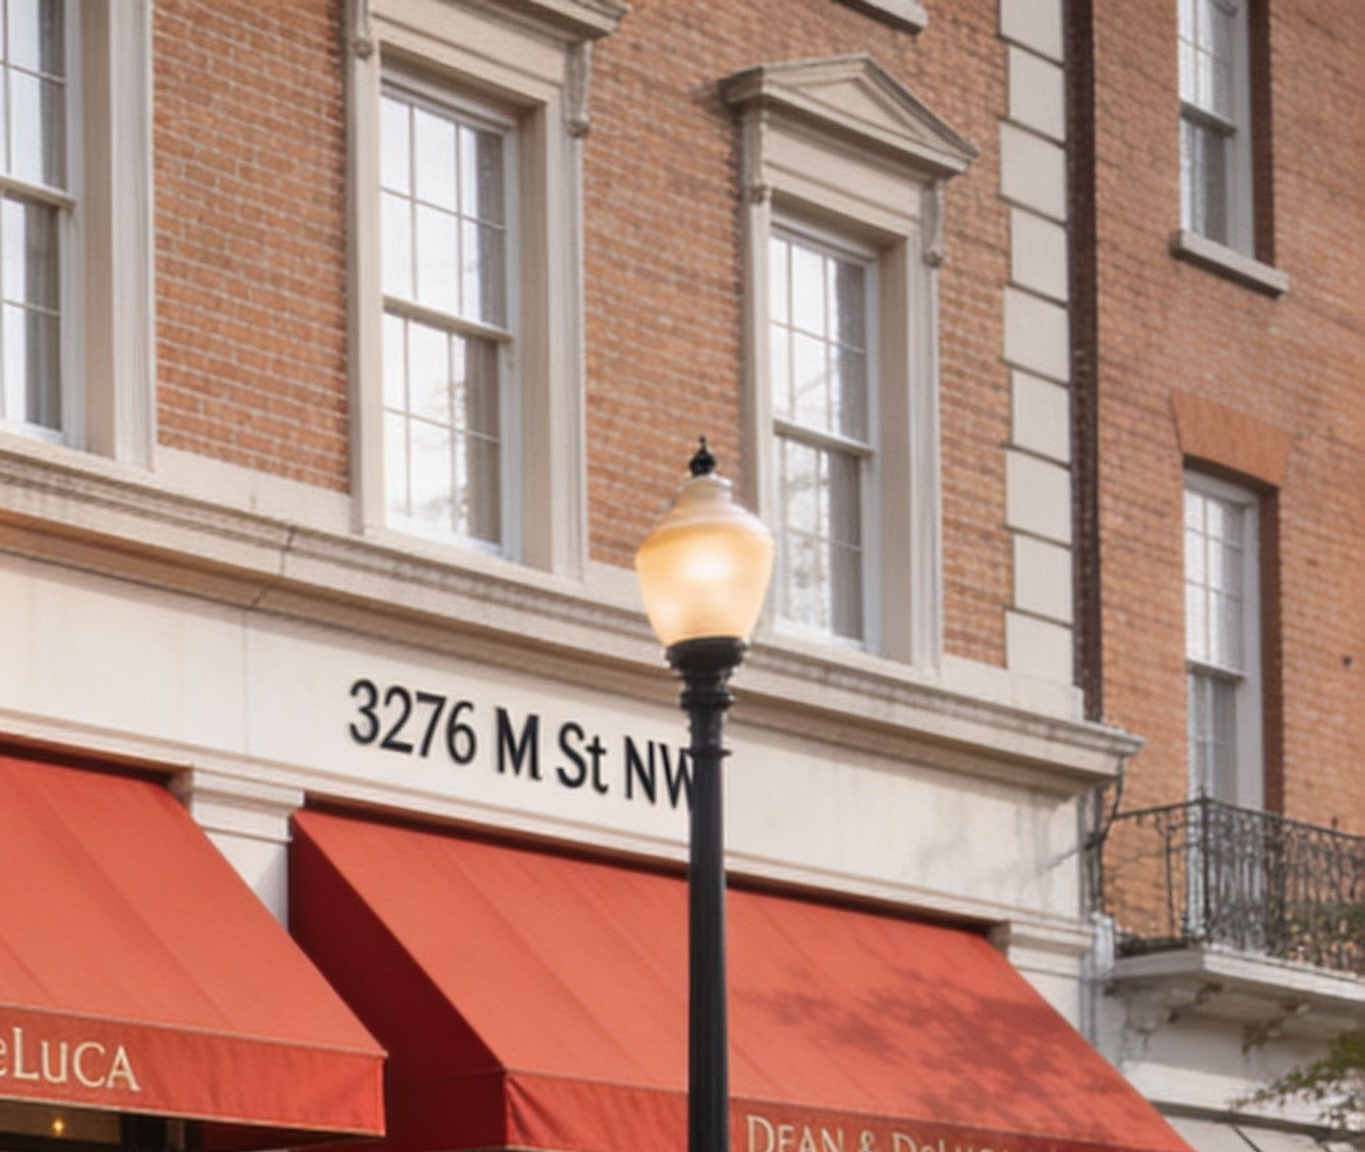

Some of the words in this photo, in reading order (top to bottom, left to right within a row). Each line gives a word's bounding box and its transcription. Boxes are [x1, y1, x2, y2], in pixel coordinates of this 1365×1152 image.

[349, 679, 476, 764] 3276
[496, 707, 541, 781] M
[556, 722, 608, 794] St
